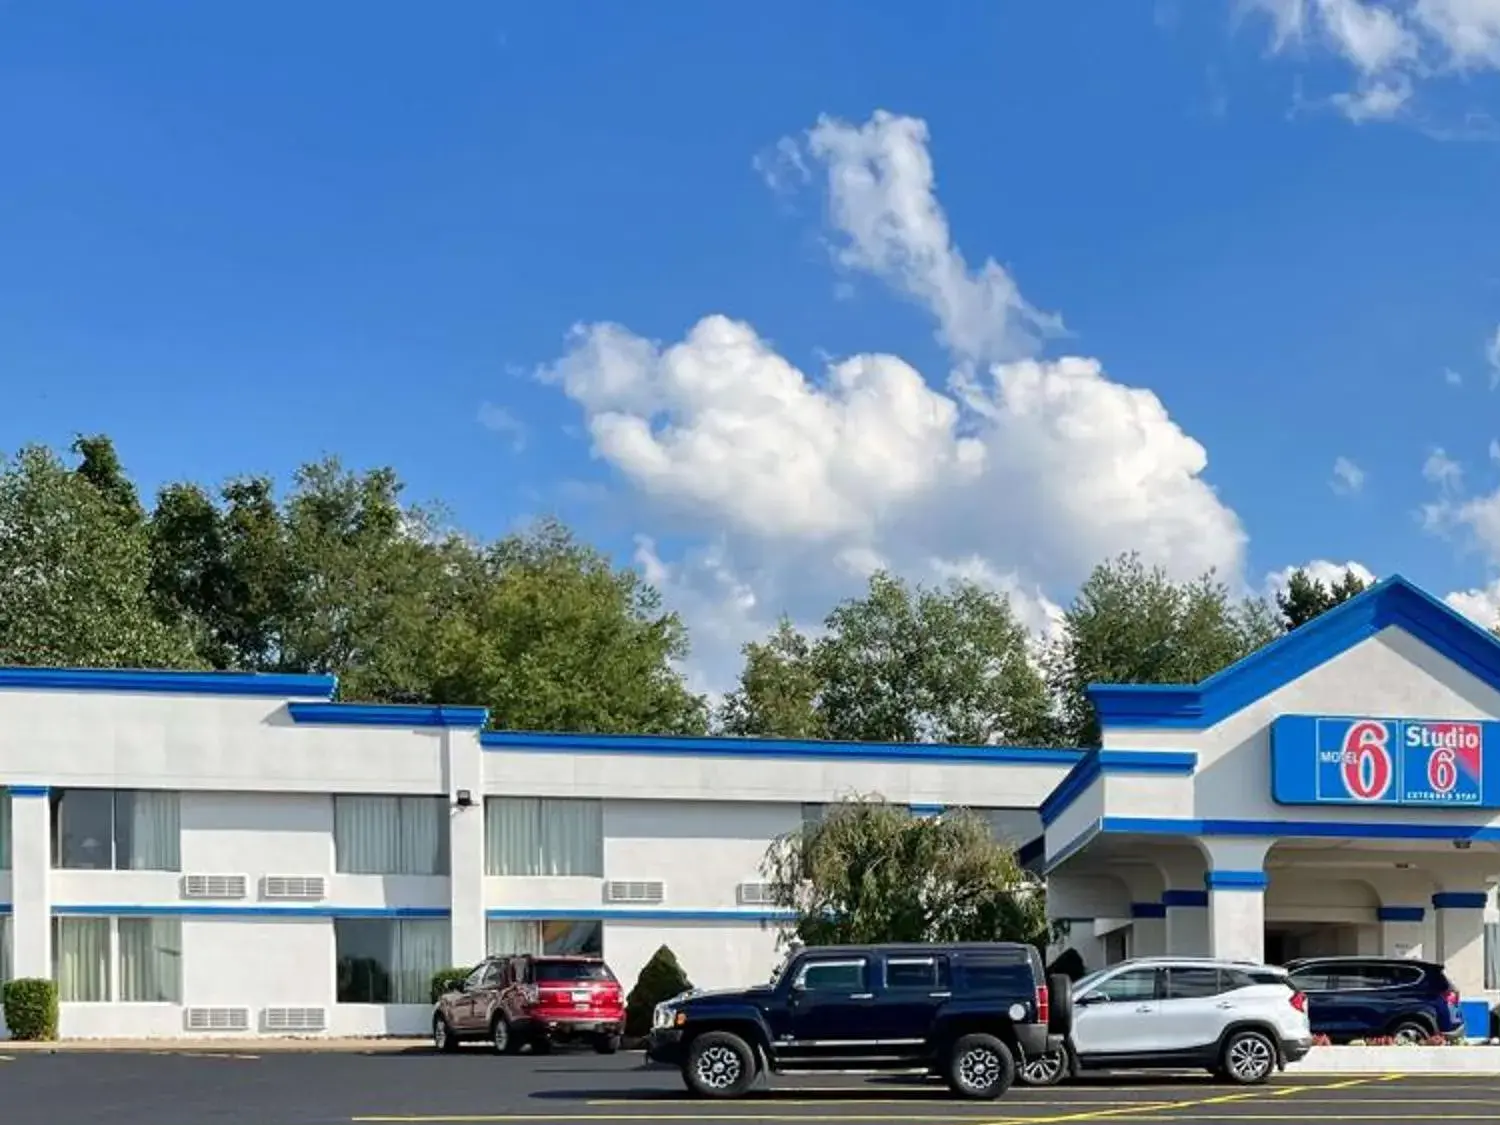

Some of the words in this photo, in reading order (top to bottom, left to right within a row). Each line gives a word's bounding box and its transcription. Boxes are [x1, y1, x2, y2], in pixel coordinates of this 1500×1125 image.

[1405, 725, 1480, 749] Studio
[1319, 751, 1360, 765] MOTEL
[1340, 719, 1393, 801] 6
[1427, 747, 1457, 792] 6
[1407, 791, 1453, 801] EXTENDED
[1455, 792, 1478, 802] STAY
